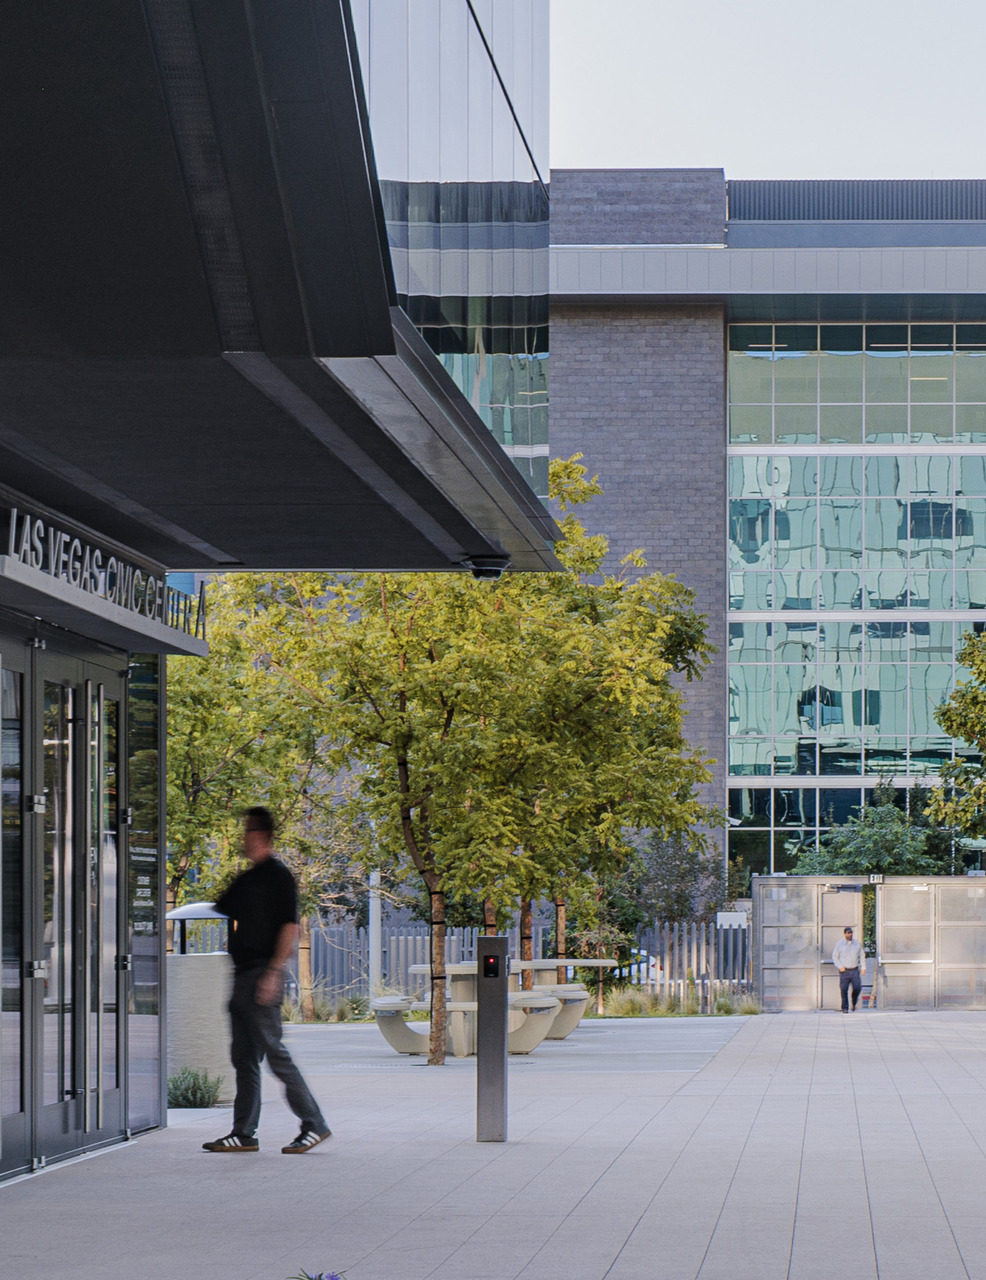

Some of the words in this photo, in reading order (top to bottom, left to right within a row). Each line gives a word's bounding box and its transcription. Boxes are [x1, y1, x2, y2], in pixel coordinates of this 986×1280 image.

[8, 508, 44, 569] LAS
[48, 527, 102, 596] VEGAS
[105, 556, 142, 614] CIVIC
[146, 575, 192, 634] CENTER
